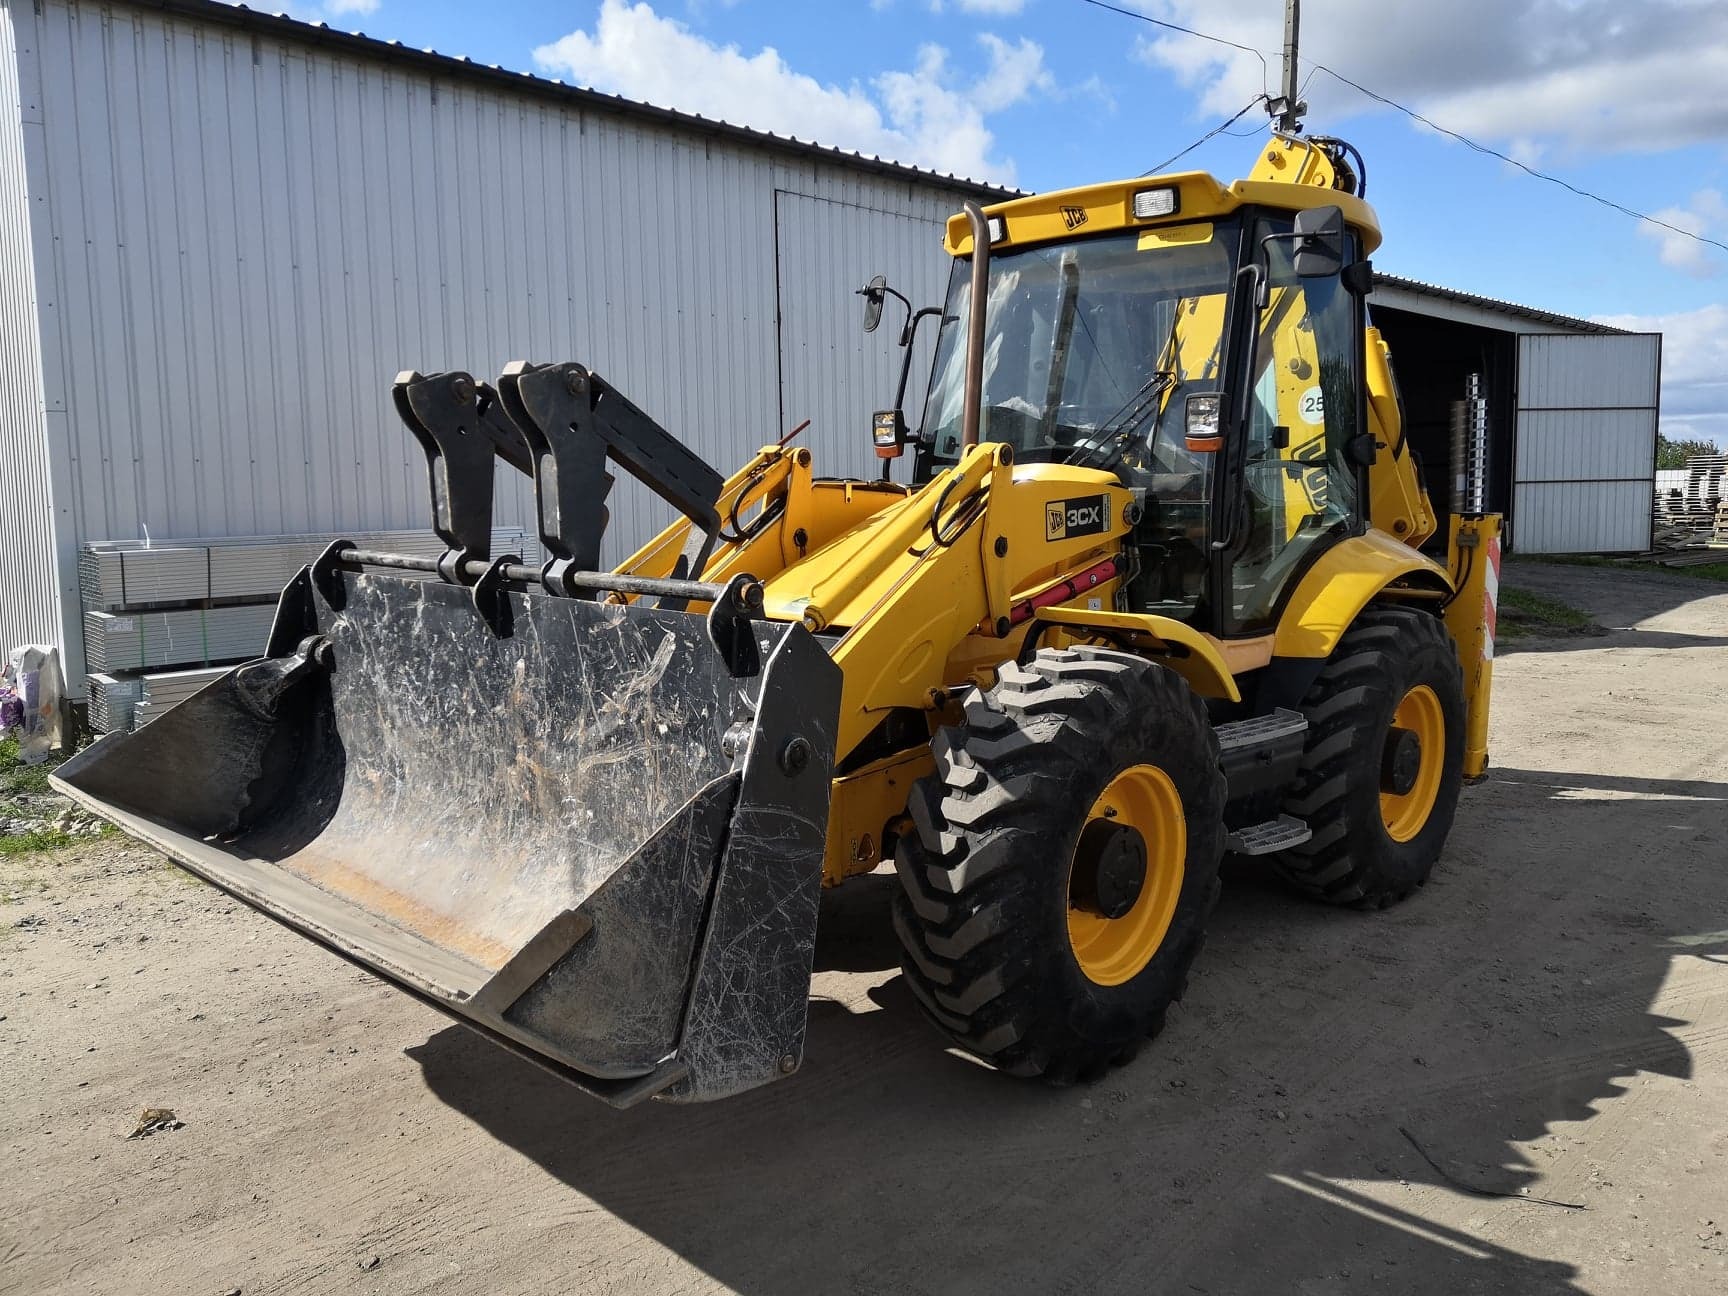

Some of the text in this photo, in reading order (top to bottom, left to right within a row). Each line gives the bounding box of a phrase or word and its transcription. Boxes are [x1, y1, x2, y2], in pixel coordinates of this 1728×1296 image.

[1064, 207, 1086, 228] JCB
[1304, 396, 1324, 413] 25
[1050, 511, 1064, 531] JCB
[1066, 506, 1100, 527] 3CX
